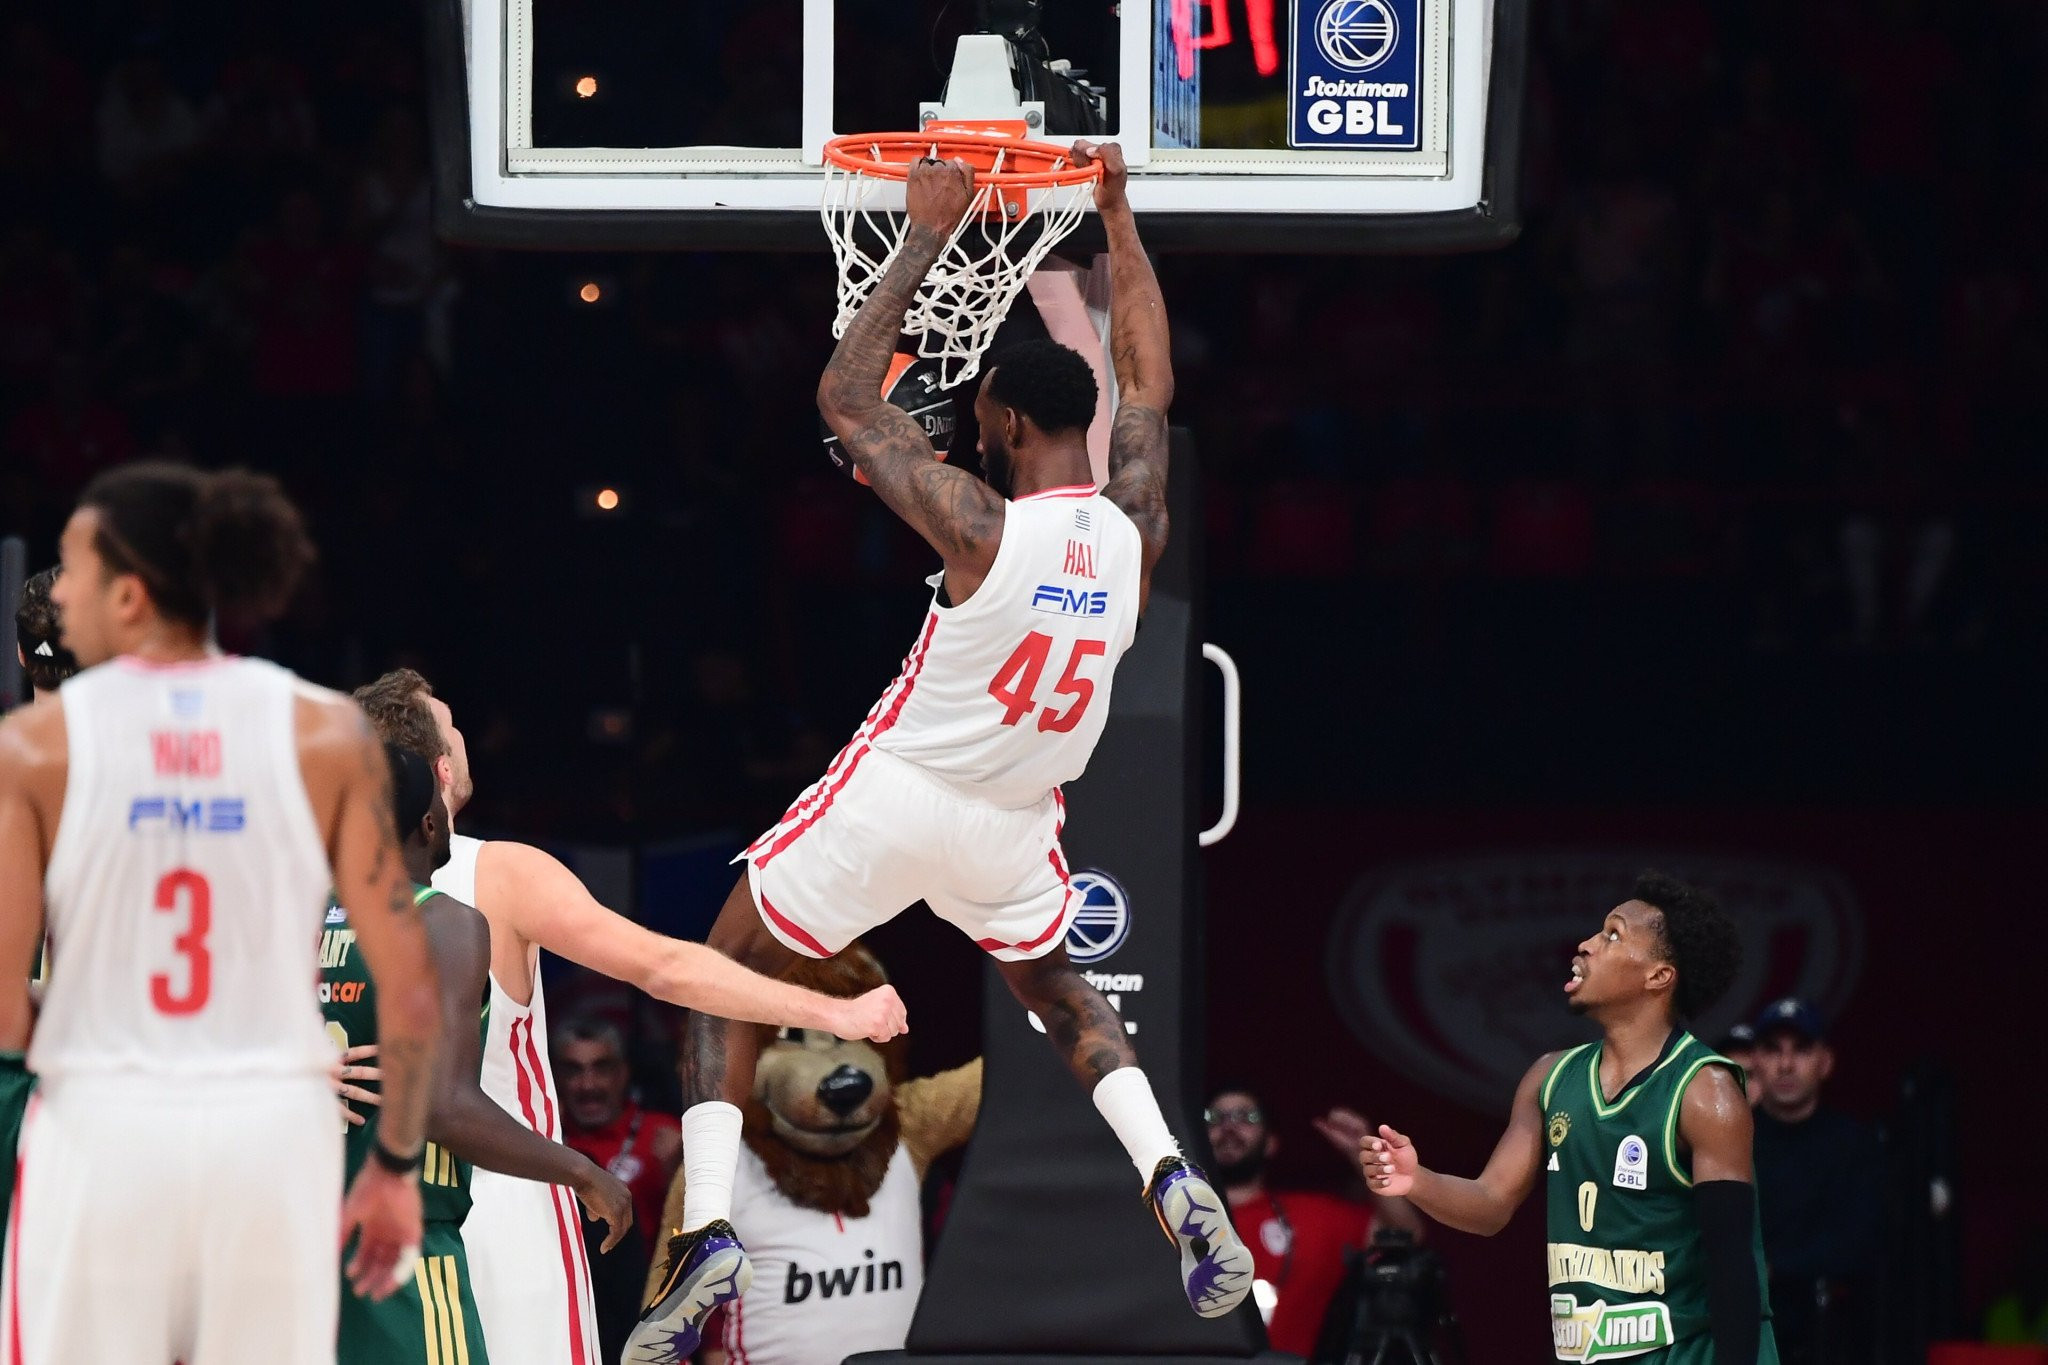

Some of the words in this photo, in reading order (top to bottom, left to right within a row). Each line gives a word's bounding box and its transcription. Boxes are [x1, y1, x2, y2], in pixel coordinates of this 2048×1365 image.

[1303, 76, 1408, 98] Stoiximan
[1307, 100, 1403, 136] GBL
[1031, 585, 1108, 615] FMS
[988, 630, 1106, 733] 45
[129, 797, 246, 831] FMS
[150, 866, 212, 1016] 3
[317, 929, 356, 969] ANT
[318, 981, 366, 1004] acar
[1617, 1173, 1643, 1187] GBL
[1578, 1181, 1598, 1232] 0
[784, 1249, 903, 1304] bwin
